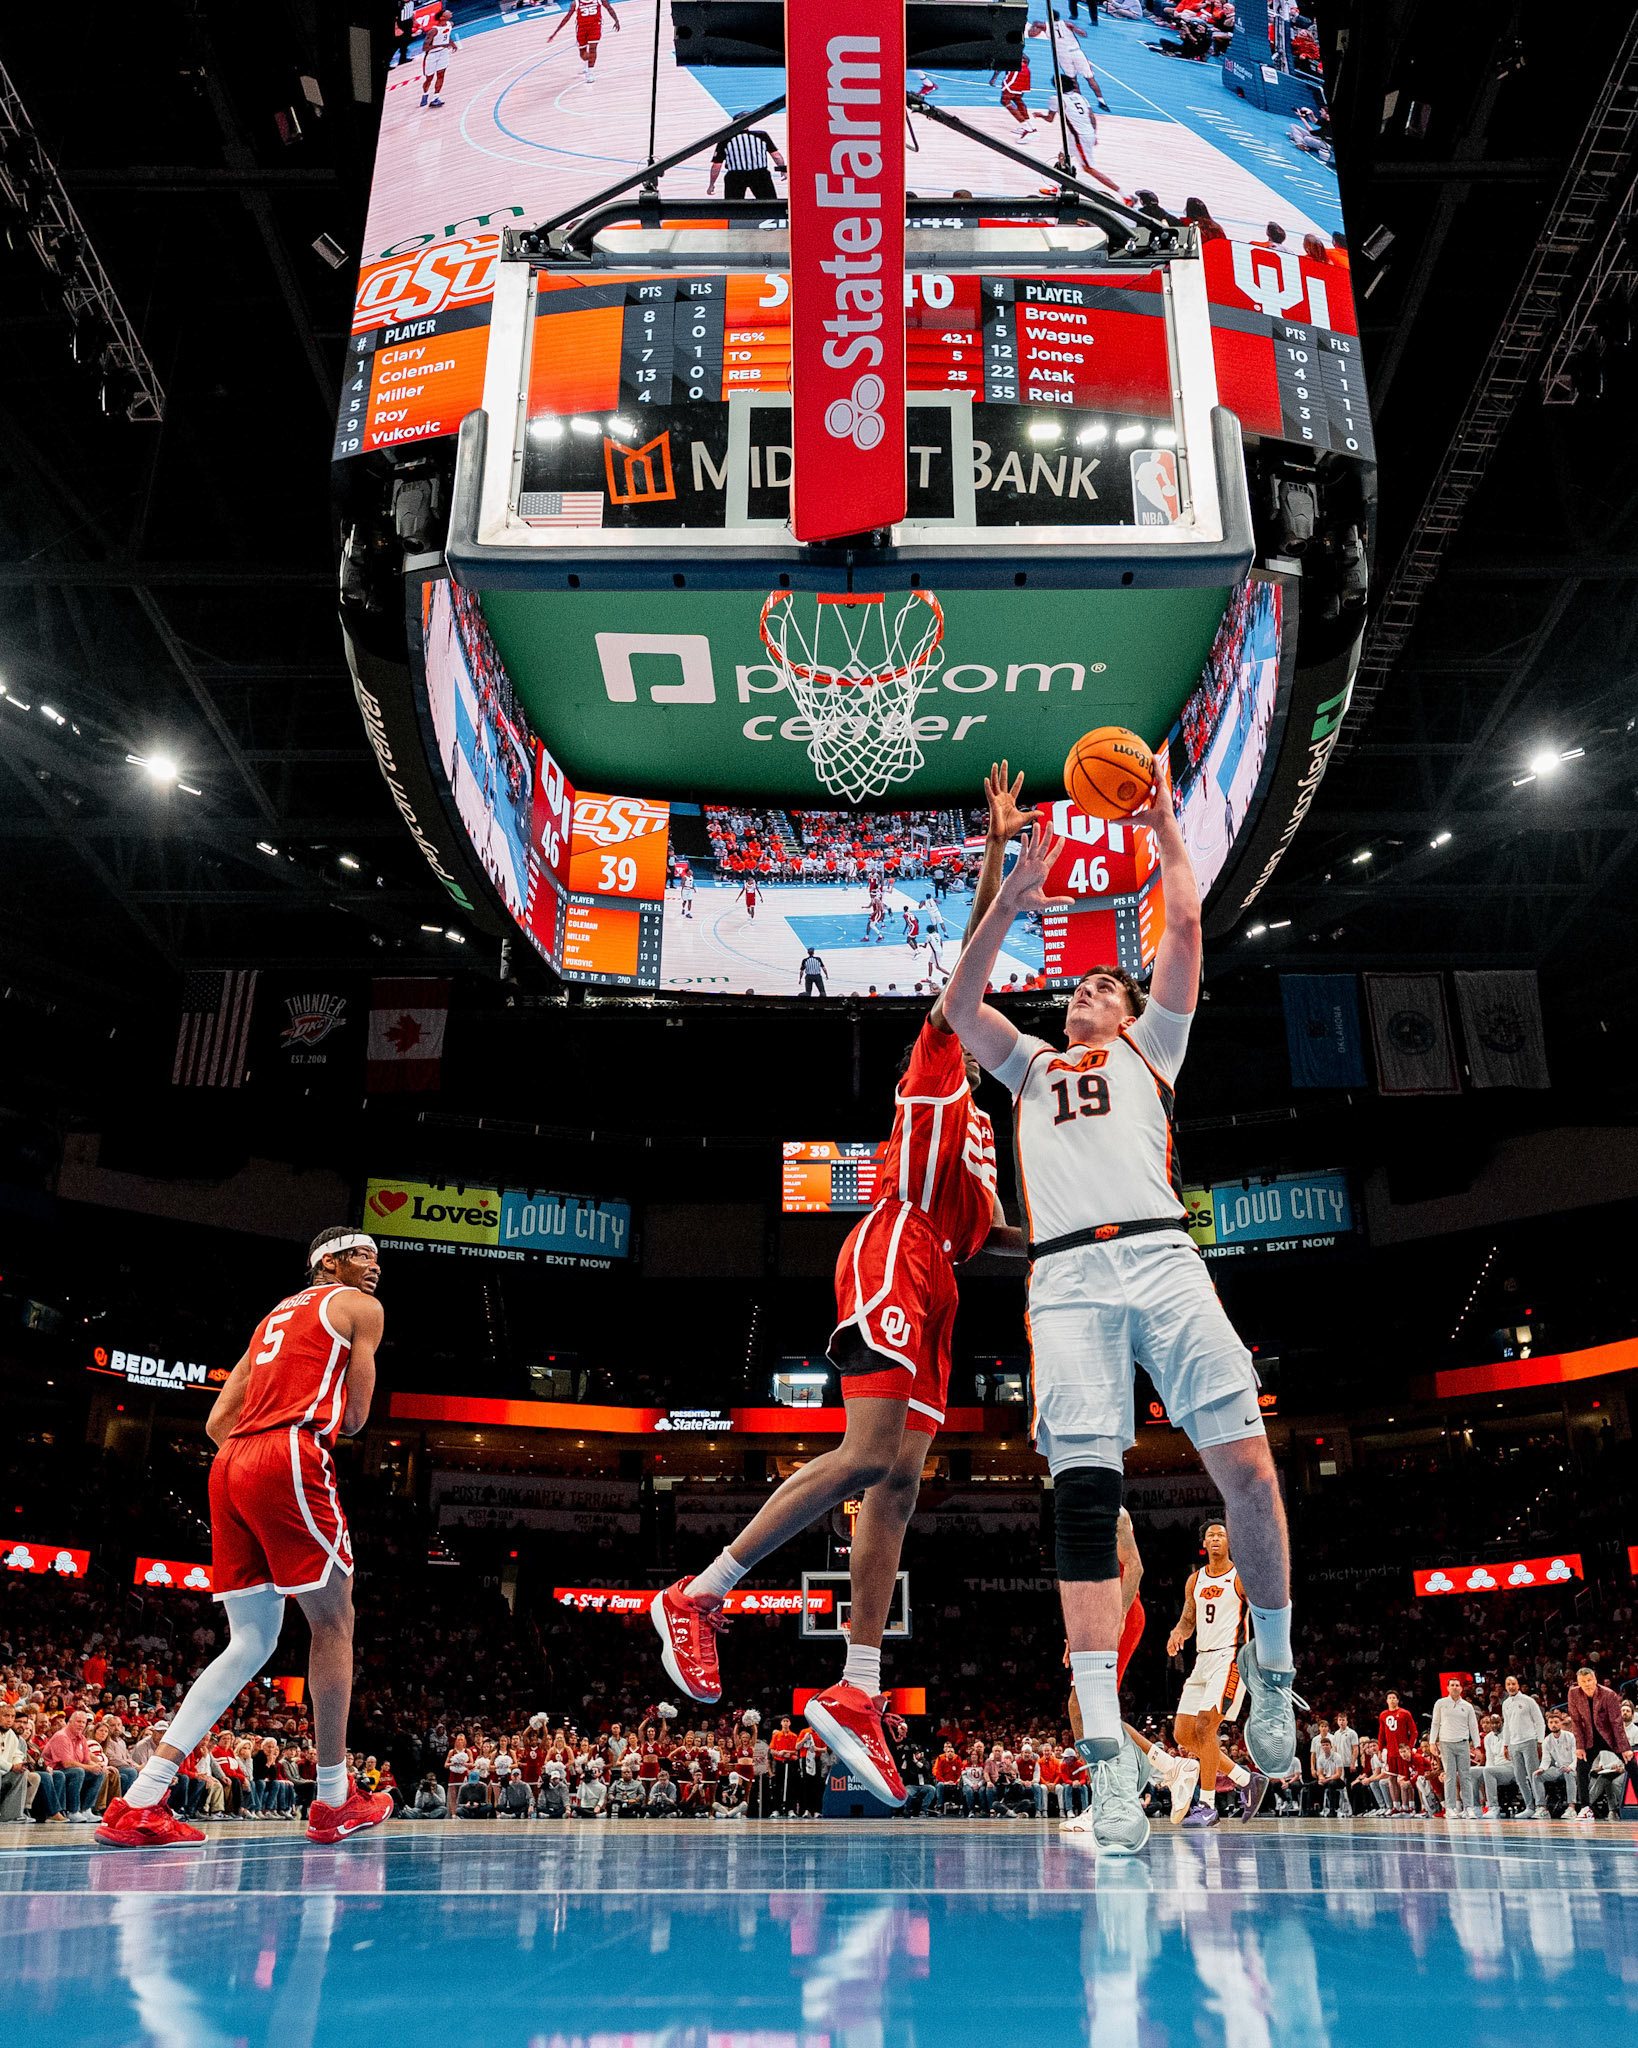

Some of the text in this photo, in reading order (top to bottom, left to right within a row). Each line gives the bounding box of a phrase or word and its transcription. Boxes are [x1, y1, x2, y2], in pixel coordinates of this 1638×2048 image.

[639, 283, 712, 298] PTS FLS
[1025, 285, 1084, 304] PLAYER
[643, 306, 706, 323] 8 2
[996, 306, 1088, 325] 1 Brown
[384, 319, 437, 344] PLAYER
[645, 325, 706, 341] 1 0
[730, 332, 766, 343] FG%
[941, 333, 973, 344] 42.1
[995, 325, 1095, 345] 5 Wague
[1285, 326, 1350, 353] PTS FLS
[357, 346, 426, 372] 1 Clary
[642, 346, 702, 362] 7 1
[729, 351, 752, 361] TO
[952, 350, 963, 361] 5
[991, 345, 1085, 364] 12 Jones
[1287, 348, 1346, 372] 10 1
[352, 360, 455, 391] 4 Coleman
[636, 366, 704, 382] 13 0
[729, 369, 762, 380] REB
[948, 371, 968, 381] 25
[990, 365, 1075, 384] 22 Atak
[1294, 368, 1349, 391] 4 1
[350, 384, 424, 412] 5 Miller
[638, 386, 703, 402] 4 0
[991, 385, 1015, 398] 35
[1028, 388, 1074, 404] Reid
[1297, 387, 1351, 411] 9 1
[347, 408, 408, 432] 9 Roy
[1300, 406, 1354, 430] 3 1
[341, 420, 441, 453] 19 Vukovic
[1302, 427, 1359, 451] 5 0
[1142, 512, 1164, 525] NBA
[598, 855, 637, 893] 39
[1067, 856, 1110, 894] 46
[570, 895, 595, 905] PLAYER
[640, 903, 652, 911] PTS
[1113, 897, 1126, 906] PTS
[569, 907, 590, 916] CLARY
[1044, 916, 1068, 925] BROWN
[568, 920, 598, 930] COLEMAN
[1044, 929, 1068, 937] WAGUE
[567, 932, 591, 942] MILLER
[1045, 941, 1065, 950] JONES
[1046, 954, 1061, 962] ATAK
[617, 976, 631, 984] 2ND
[284, 993, 348, 1017] THUNDER
[290, 1055, 327, 1064] EST. 2008
[1050, 1074, 1112, 1127] 19
[809, 1145, 830, 1157] 39
[1220, 1189, 1282, 1236] LOUD
[1290, 1187, 1344, 1223] CITY
[505, 1203, 566, 1240] LOUD
[576, 1205, 625, 1249] CITY
[1266, 1240, 1298, 1252] EXIT
[1302, 1237, 1335, 1248] NOW
[380, 1239, 611, 1269] BRING THE THUNDER EXIT NOW
[880, 1306, 911, 1347] OU
[255, 1310, 295, 1365] 5
[110, 1350, 207, 1384] BEDLAM
[127, 1373, 186, 1390] BASKETBALL
[1169, 1486, 1209, 1503] PARTY
[1205, 1604, 1216, 1624] 9
[1386, 1715, 1398, 1731] OU
